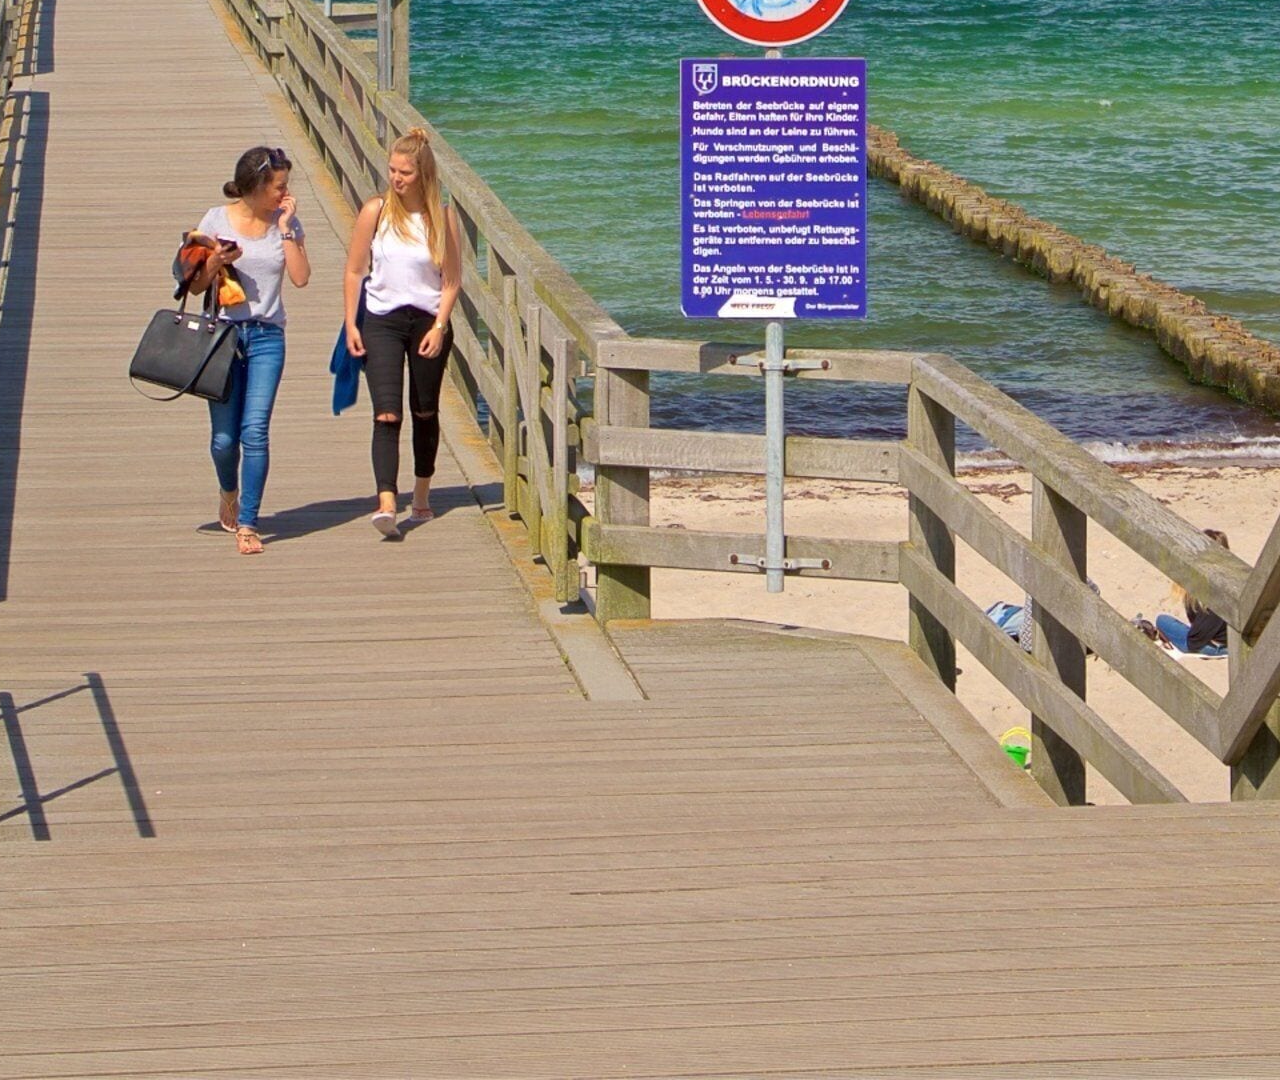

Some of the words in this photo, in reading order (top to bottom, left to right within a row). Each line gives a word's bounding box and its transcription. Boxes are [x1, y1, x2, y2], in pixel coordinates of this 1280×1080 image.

[722, 75, 860, 87] BRÜCKENORDNUNG
[692, 101, 732, 110] Betreten
[735, 101, 752, 110] der
[755, 101, 805, 110] Seebrücke
[808, 101, 825, 110] auf
[827, 103, 859, 113] eigene
[692, 112, 727, 123] Gefahr,
[728, 112, 757, 121] Eltern
[758, 112, 788, 121] haften
[789, 112, 803, 121] für
[825, 112, 859, 121] Kinder.
[692, 126, 724, 136] Hunde
[726, 126, 747, 136] sind
[749, 128, 761, 136] an
[763, 126, 779, 136] der
[781, 126, 808, 136] Leine
[809, 128, 822, 136] zu
[823, 126, 858, 136] führen.
[692, 143, 709, 152] Für
[713, 143, 794, 154] Verschmutzungen
[799, 143, 817, 152] und
[822, 143, 860, 152] Beschä-
[692, 154, 736, 165] digungen
[737, 154, 771, 163] werden
[772, 154, 817, 163] Gebühren
[818, 154, 859, 163] erhoben.
[693, 172, 713, 181] Das
[714, 172, 767, 181] Radfahren
[768, 172, 785, 181] auf
[786, 172, 804, 181] der
[805, 172, 859, 181] Seebrücke
[693, 183, 706, 192] ist
[708, 183, 756, 192] verboten.
[693, 198, 712, 207] Das
[713, 198, 756, 209] Springen
[777, 198, 794, 207] der
[795, 198, 845, 207] Seebrücke
[846, 198, 860, 207] ist
[693, 209, 735, 218] verboten
[742, 209, 810, 220] Lebensgefahr!
[693, 224, 705, 233] Es
[707, 224, 720, 233] ist
[722, 224, 767, 235] verboten,
[768, 224, 811, 235] unbefugt
[812, 224, 860, 235] Rettungs-
[692, 235, 723, 246] geräte
[737, 235, 783, 244] entfernen
[784, 235, 806, 244] oder
[821, 235, 860, 244] beschä-
[692, 247, 722, 257] digen.
[693, 264, 711, 273] Das
[712, 264, 746, 275] Angeln
[767, 264, 784, 273] der
[785, 264, 834, 273] Seebrücke
[836, 264, 848, 273] ist
[850, 264, 859, 273] in
[692, 275, 709, 284] der
[710, 275, 729, 284] Zeit
[754, 275, 763, 284] 1.
[765, 275, 774, 284] 5.
[782, 275, 797, 284] 30.
[813, 275, 825, 284] ab
[828, 275, 853, 284] 17.00
[714, 286, 732, 295] Uhr
[733, 286, 775, 297] morgens
[776, 286, 819, 297] gestattet.
